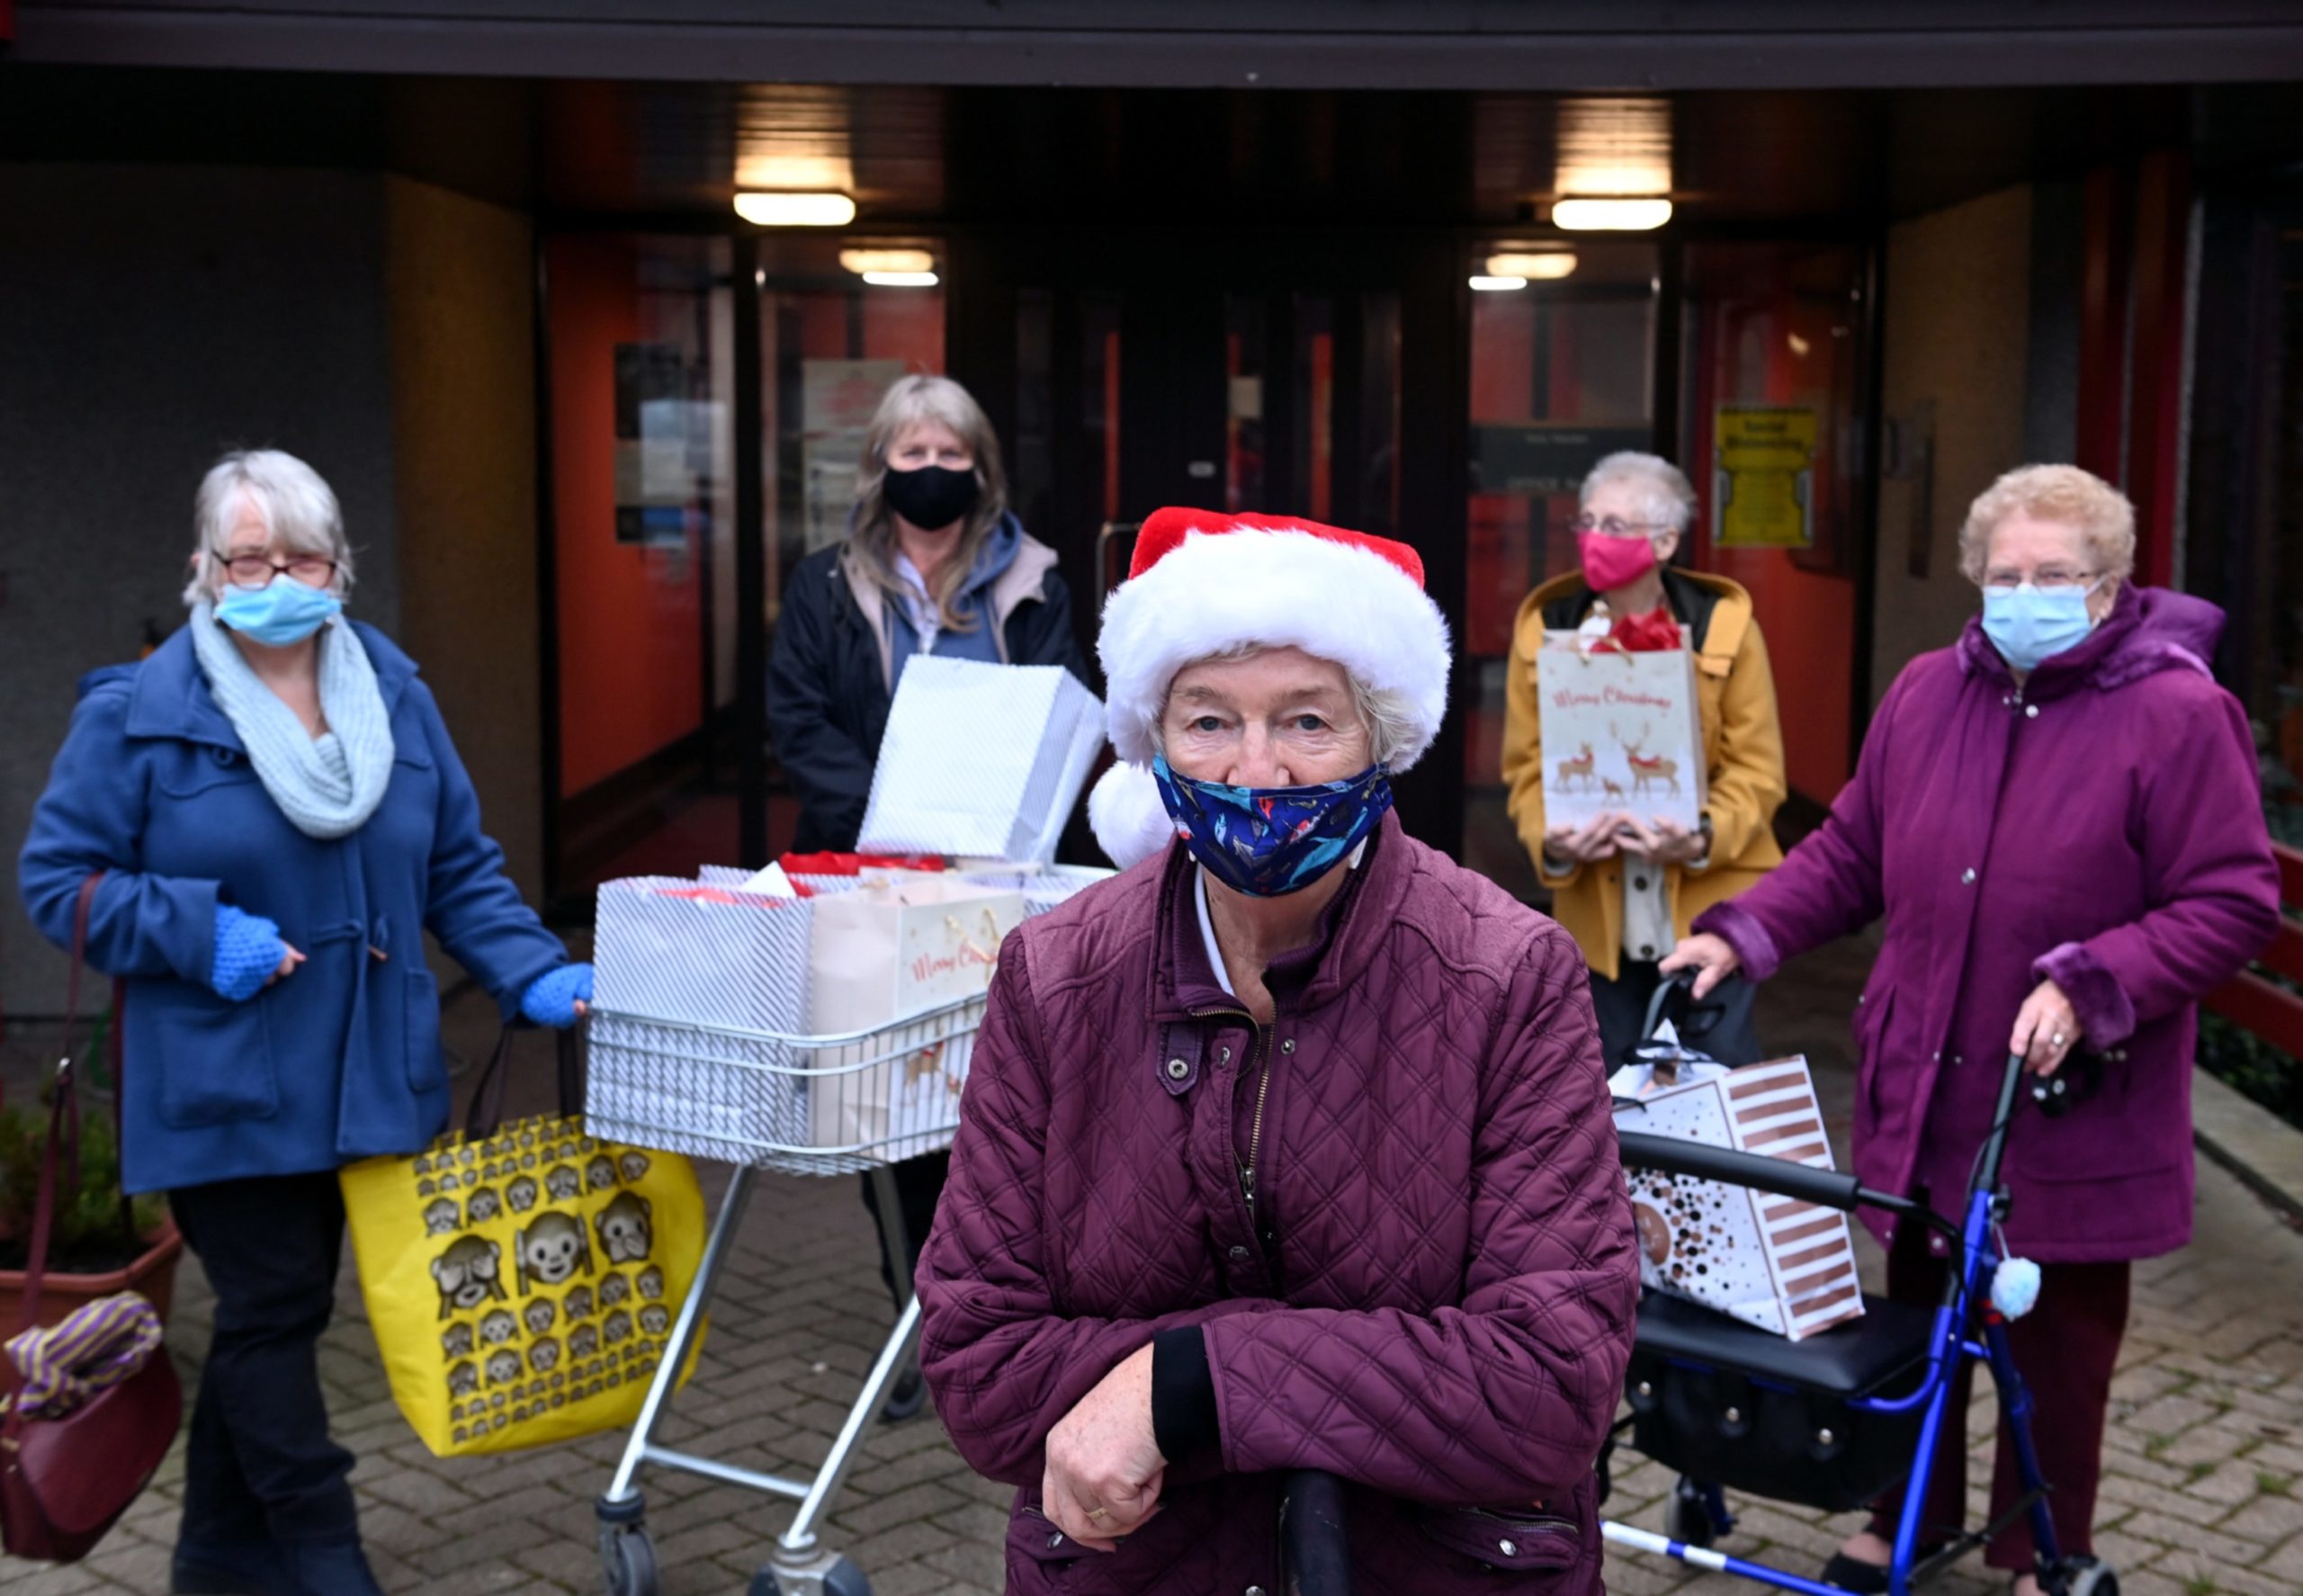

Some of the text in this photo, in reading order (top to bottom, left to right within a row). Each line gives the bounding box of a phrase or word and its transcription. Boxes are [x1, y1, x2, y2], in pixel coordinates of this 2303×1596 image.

[1552, 686, 1671, 709] Merry Christmas
[912, 954, 955, 981] Merry
